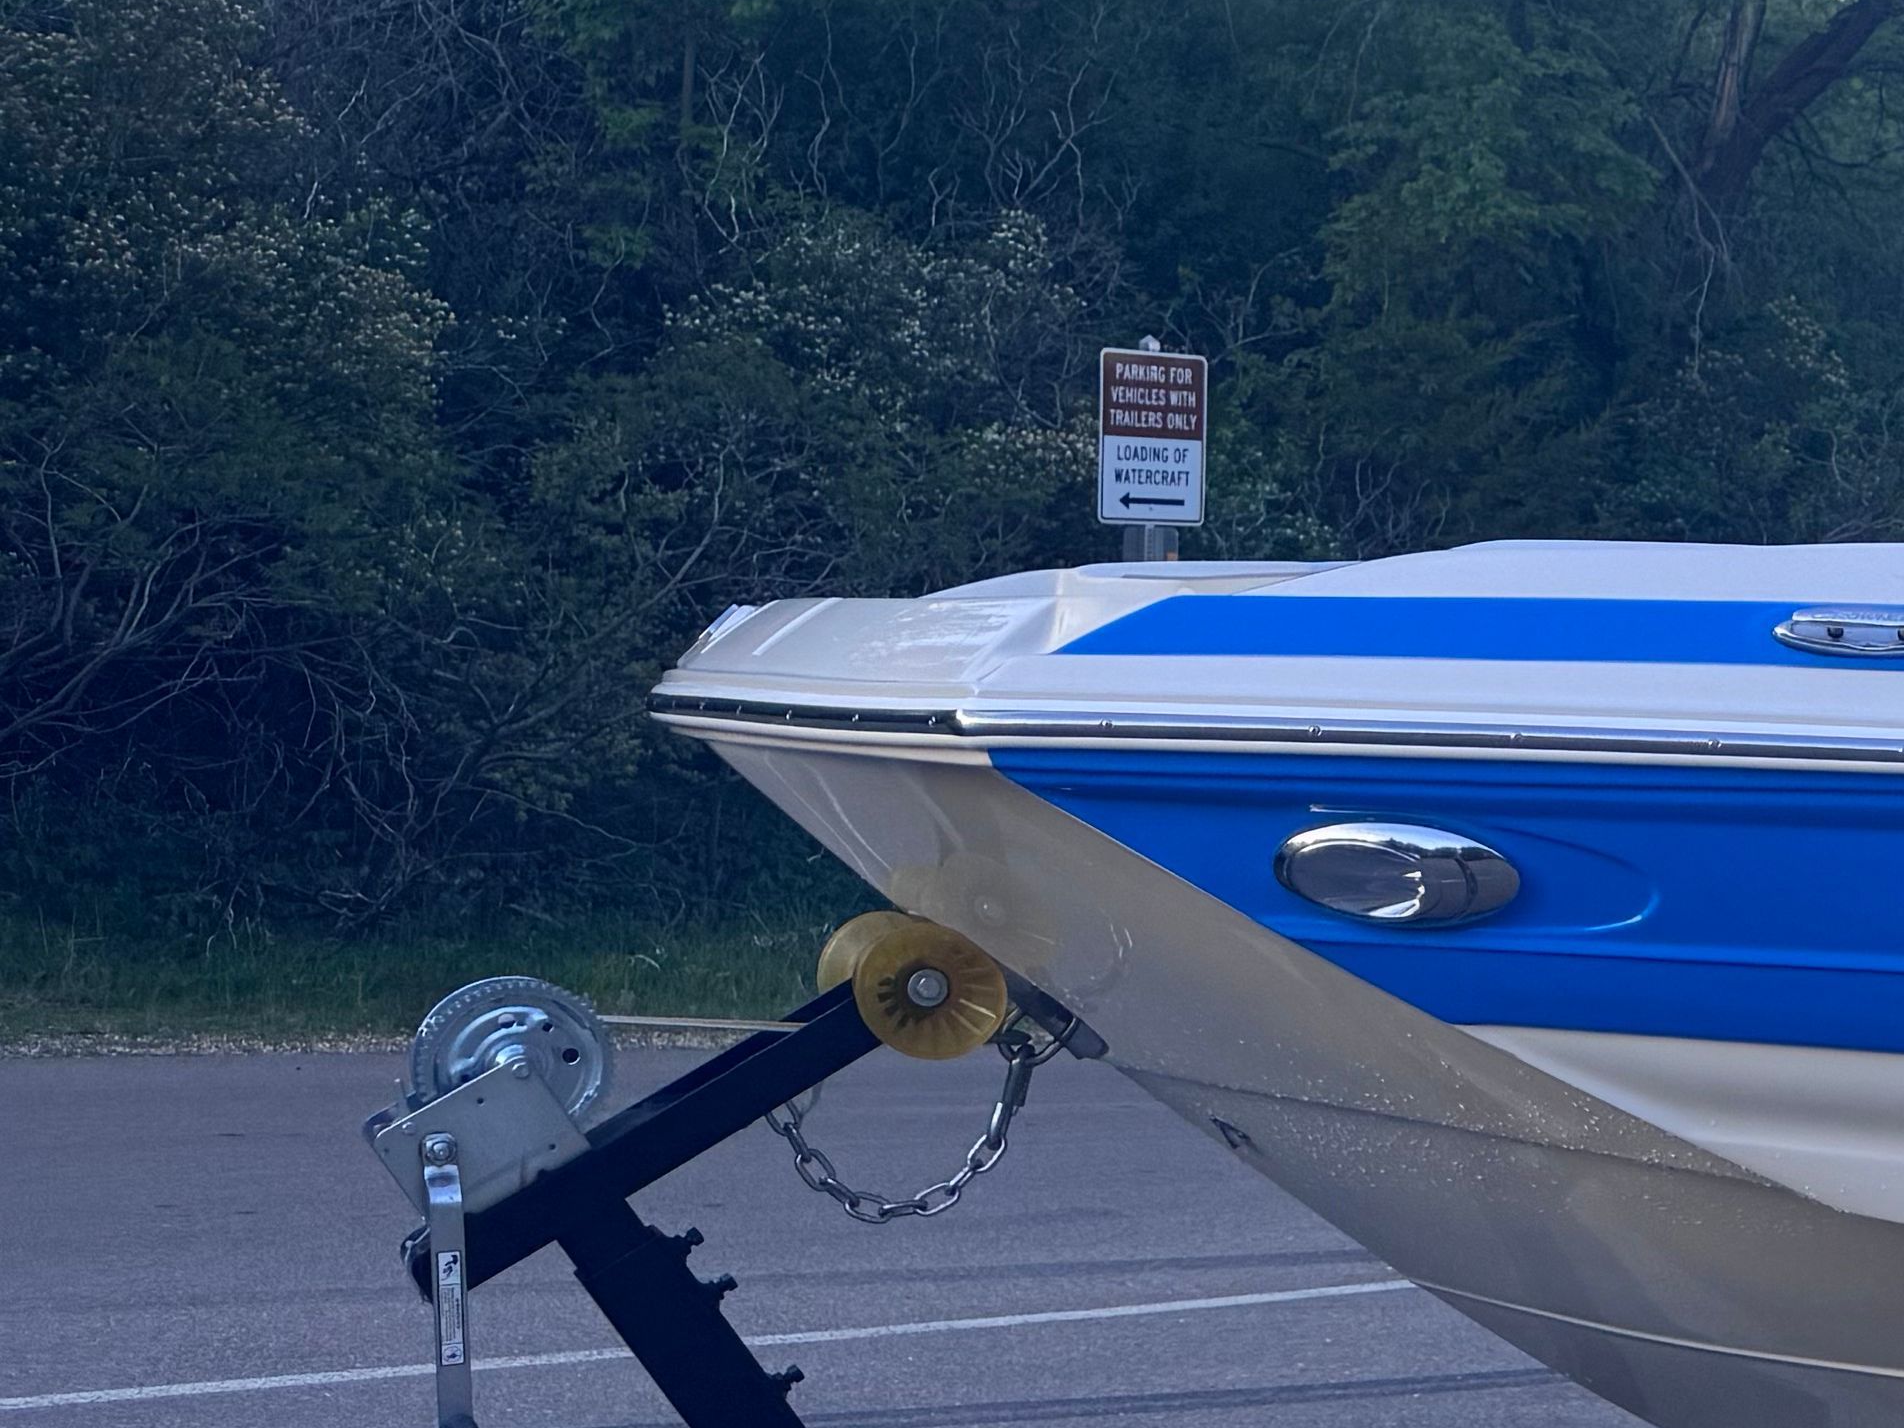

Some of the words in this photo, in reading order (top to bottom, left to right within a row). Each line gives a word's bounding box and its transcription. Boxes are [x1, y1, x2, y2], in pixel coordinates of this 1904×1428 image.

[1115, 362, 1166, 383] PARKING
[1170, 367, 1193, 385] FOR
[1111, 386, 1166, 406] VEHICLES
[1169, 391, 1196, 408] WITH
[1109, 408, 1164, 429] TRAILERS
[1167, 413, 1198, 431] ONLY
[1116, 445, 1169, 463] LOADING
[1174, 448, 1189, 463] OF
[1114, 468, 1190, 487] WATERCRAFT
